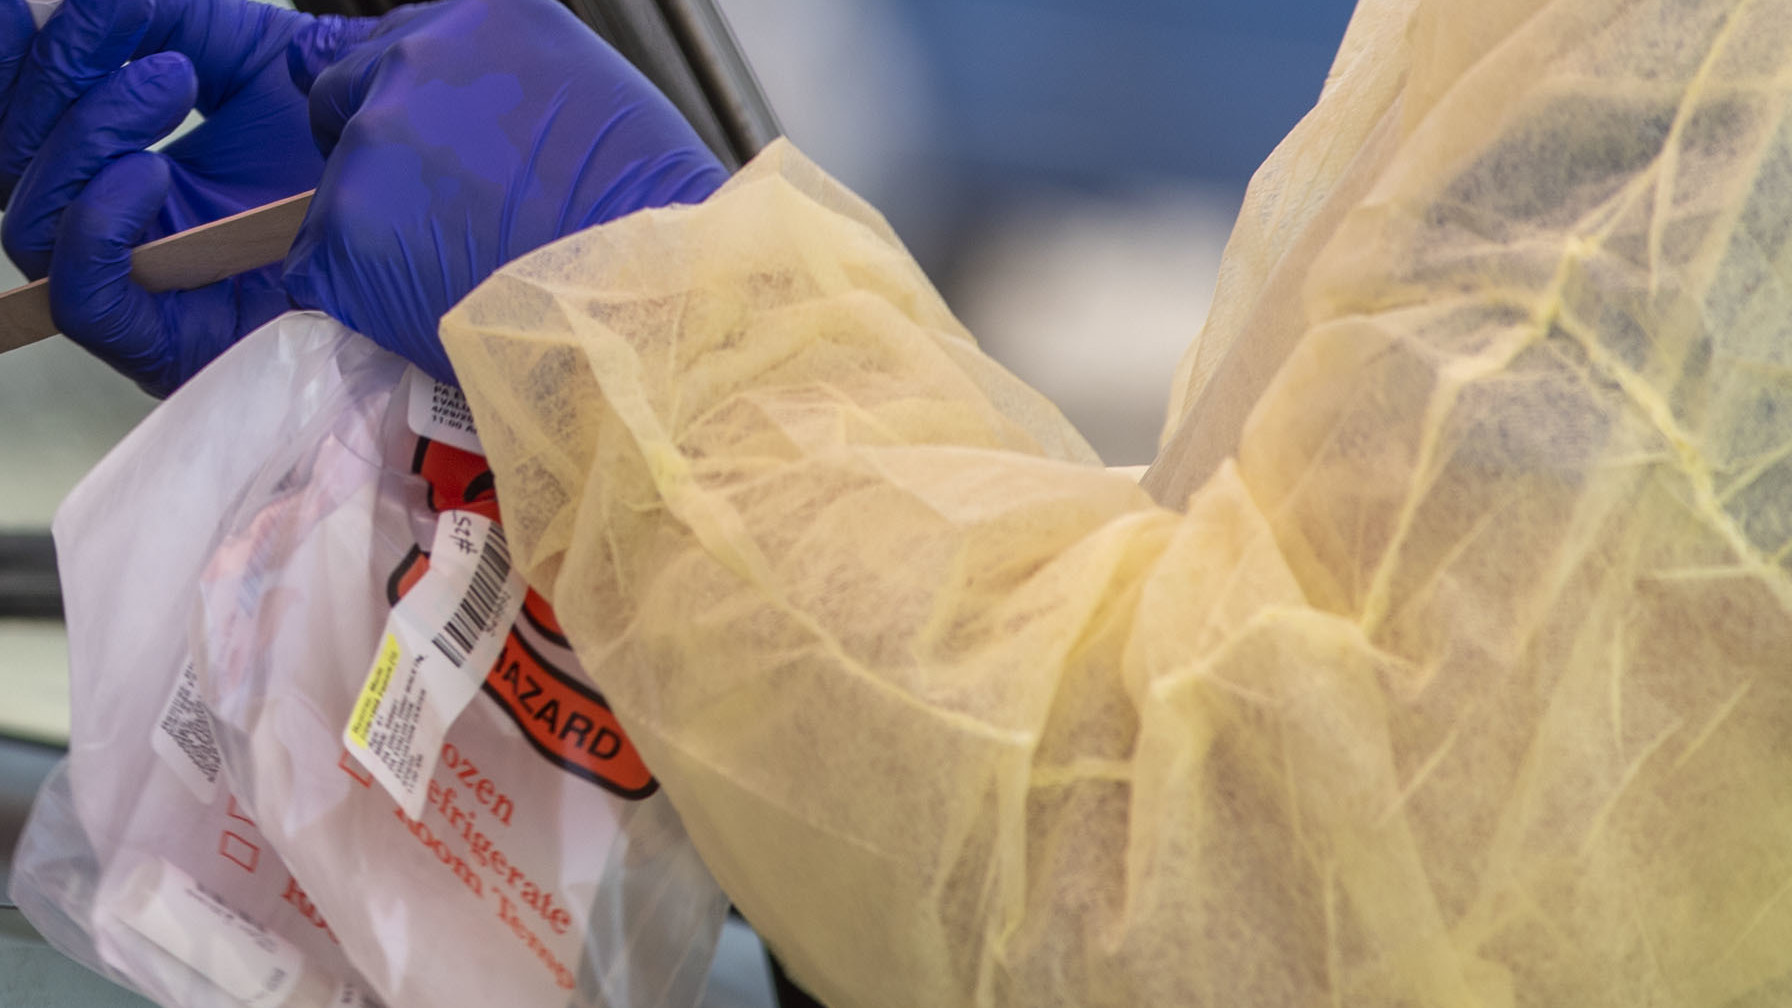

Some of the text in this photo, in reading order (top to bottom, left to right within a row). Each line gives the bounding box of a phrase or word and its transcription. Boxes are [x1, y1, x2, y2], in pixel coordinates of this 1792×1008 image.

[449, 509, 478, 554] #25
[441, 743, 514, 827] ozen
[427, 779, 571, 935] efrigerate
